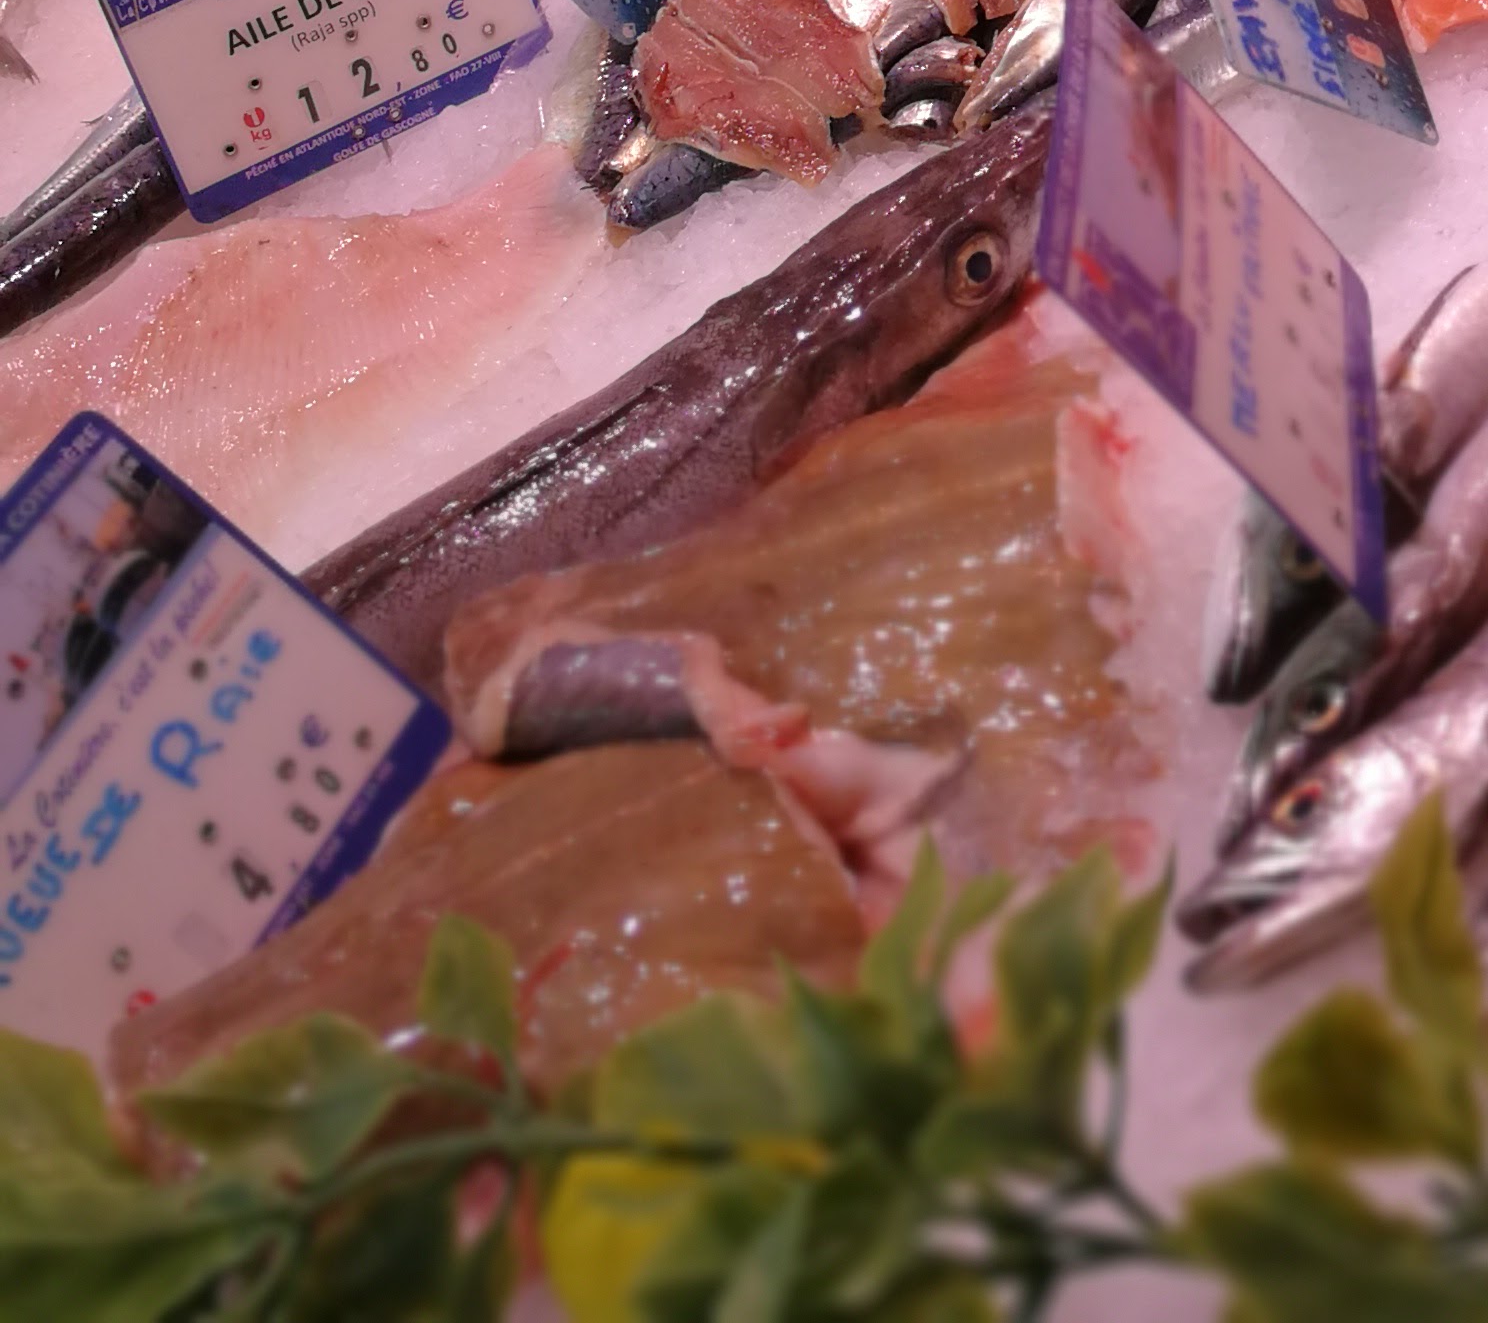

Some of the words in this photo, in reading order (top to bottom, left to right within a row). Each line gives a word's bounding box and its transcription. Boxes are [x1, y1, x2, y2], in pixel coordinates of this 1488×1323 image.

[228, 5, 294, 56] AILE
[290, 22, 336, 53] (Raja
[339, 0, 378, 31] spp)
[250, 127, 273, 143] kg
[278, 150, 295, 164] EN
[295, 120, 358, 157] ATLANTIQUE
[411, 79, 442, 100] ZONE
[332, 140, 366, 163] GOLFE
[365, 133, 382, 148] DE
[380, 105, 437, 141] GASCOGNE
[0, 828, 82, 989] UEUE
[80, 781, 143, 867] DE
